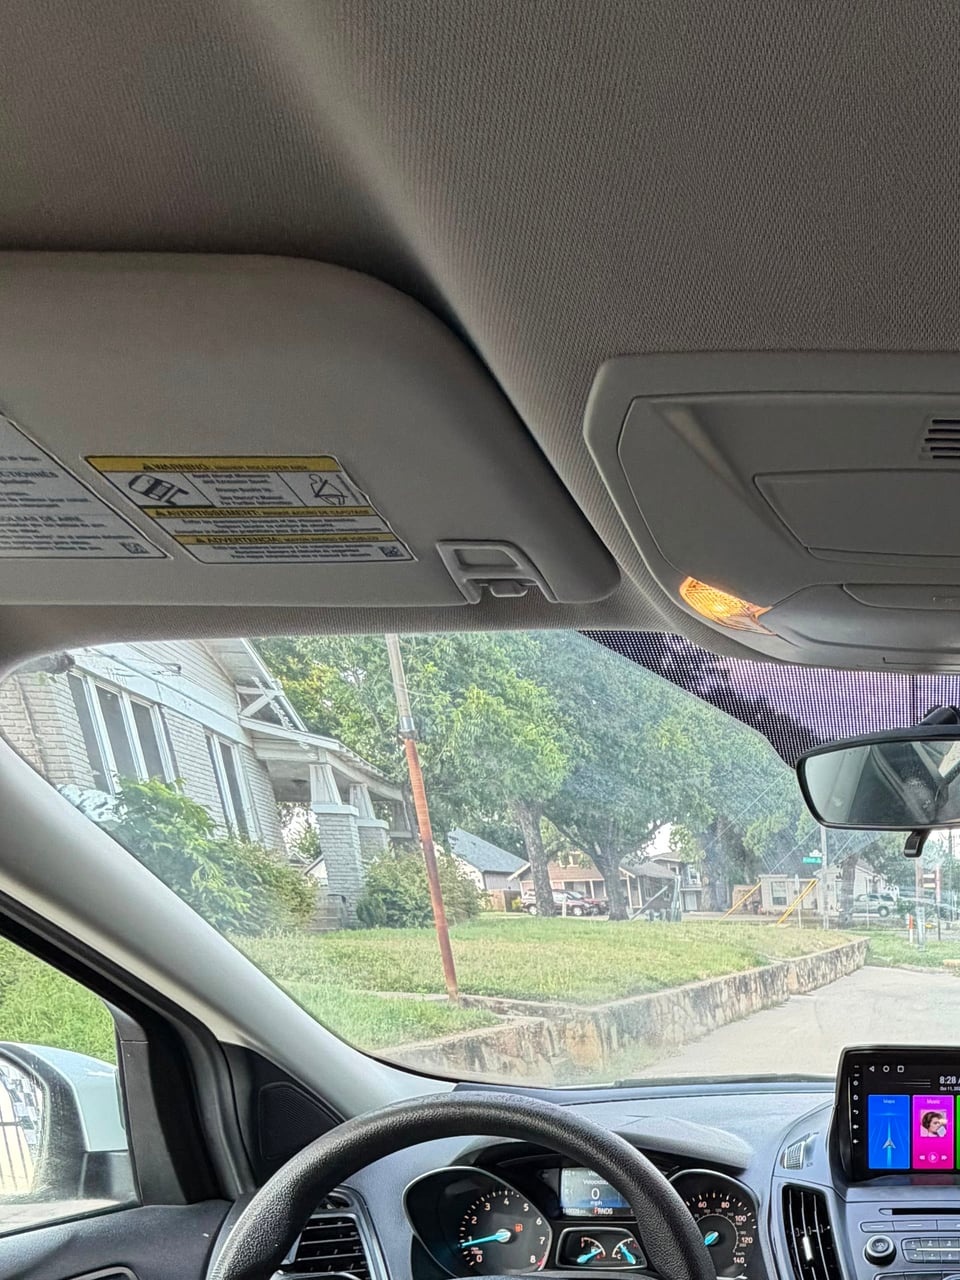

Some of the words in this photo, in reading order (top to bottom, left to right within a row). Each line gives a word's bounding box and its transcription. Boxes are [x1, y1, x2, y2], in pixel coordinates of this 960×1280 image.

[153, 463, 210, 471] WARNING:
[166, 509, 261, 517] AVERTISSEMENT:
[940, 1076, 956, 1084] 8:28
[591, 1188, 600, 1199] 0
[504, 1198, 510, 1206] 4
[484, 1203, 491, 1211] 3
[523, 1203, 529, 1211] 5
[471, 1216, 478, 1224] 2
[536, 1217, 542, 1225] 6
[539, 1237, 545, 1245] 7
[476, 1255, 483, 1263] 0
[530, 1255, 536, 1263] 8
